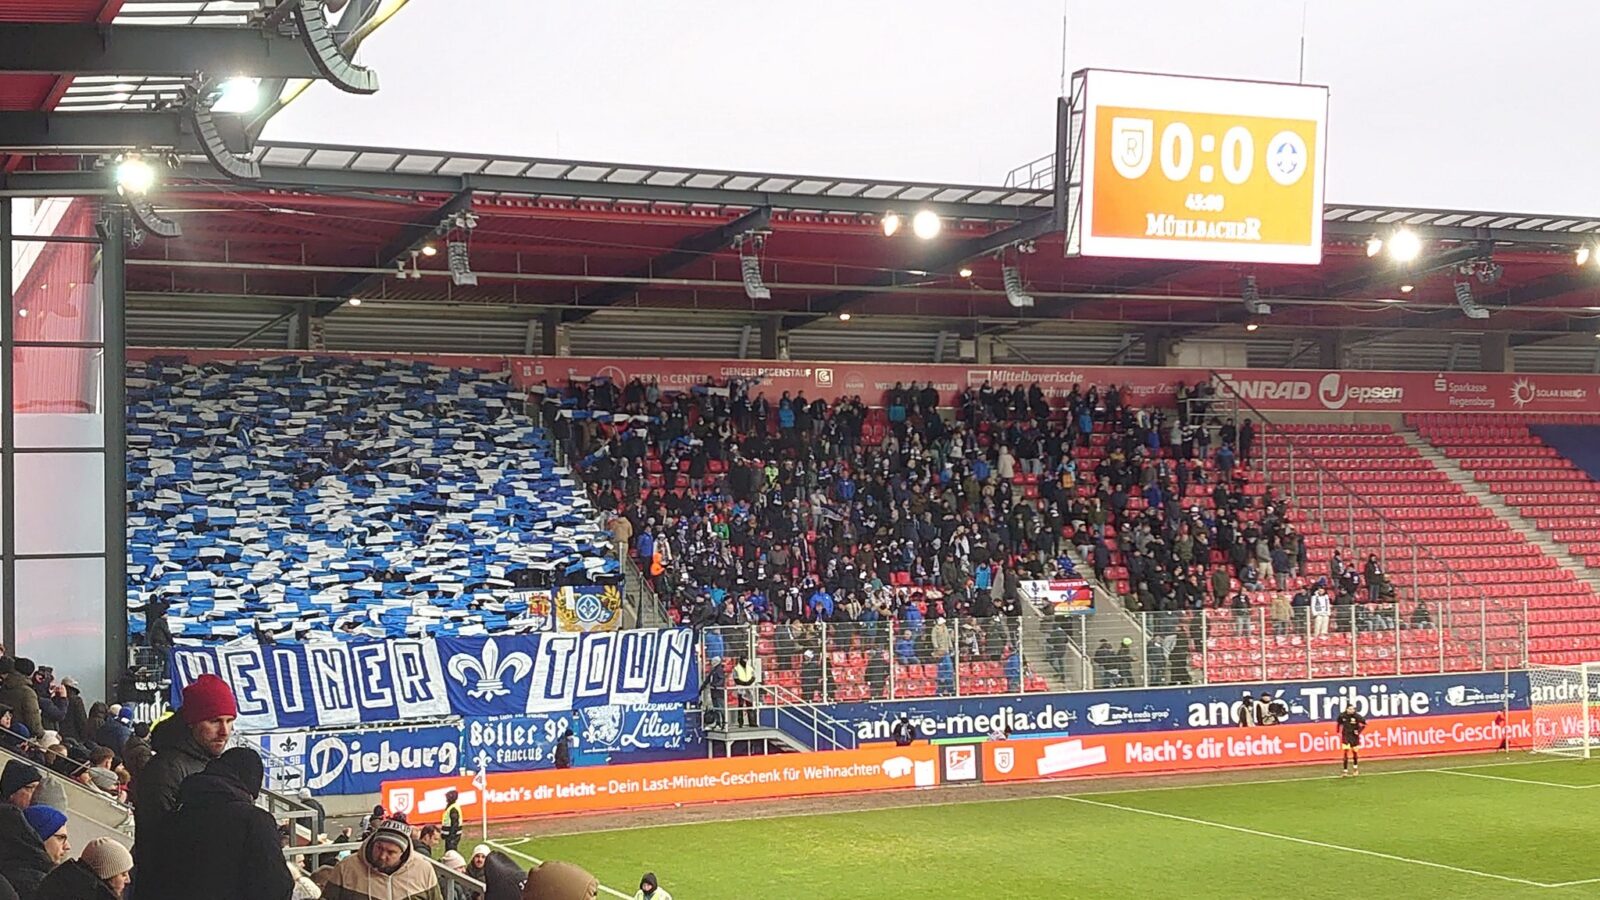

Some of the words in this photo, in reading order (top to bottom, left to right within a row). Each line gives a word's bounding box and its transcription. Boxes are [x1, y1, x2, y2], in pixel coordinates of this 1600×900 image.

[670, 374, 708, 384] CENTER
[992, 370, 1084, 384] Mittelbayerische
[1448, 382, 1487, 394] Sparkasse
[1536, 389, 1558, 398] SOLAR
[1560, 389, 1587, 398] ENERGY
[1449, 396, 1495, 408] Regensburg
[544, 629, 693, 699] TOWN
[469, 720, 538, 746] Böller
[621, 711, 683, 748] Lilien
[1125, 740, 1193, 763] Mach's
[1196, 737, 1224, 759] dir
[1227, 735, 1283, 757] leicht
[1300, 730, 1341, 752] Dein
[1358, 718, 1532, 750] ast-Minute-Geschenk
[1536, 717, 1558, 738] für
[1561, 714, 1600, 735] Weh
[307, 737, 457, 789] Dieburg
[496, 748, 543, 763] FANCLUB
[484, 786, 531, 804] Mach's
[534, 782, 553, 800] dir
[556, 779, 597, 798] leicht
[608, 779, 639, 795] Dein
[643, 768, 780, 792] Last-Minute-Geschenk
[783, 768, 801, 781] für
[803, 762, 881, 780] Weihnachten
